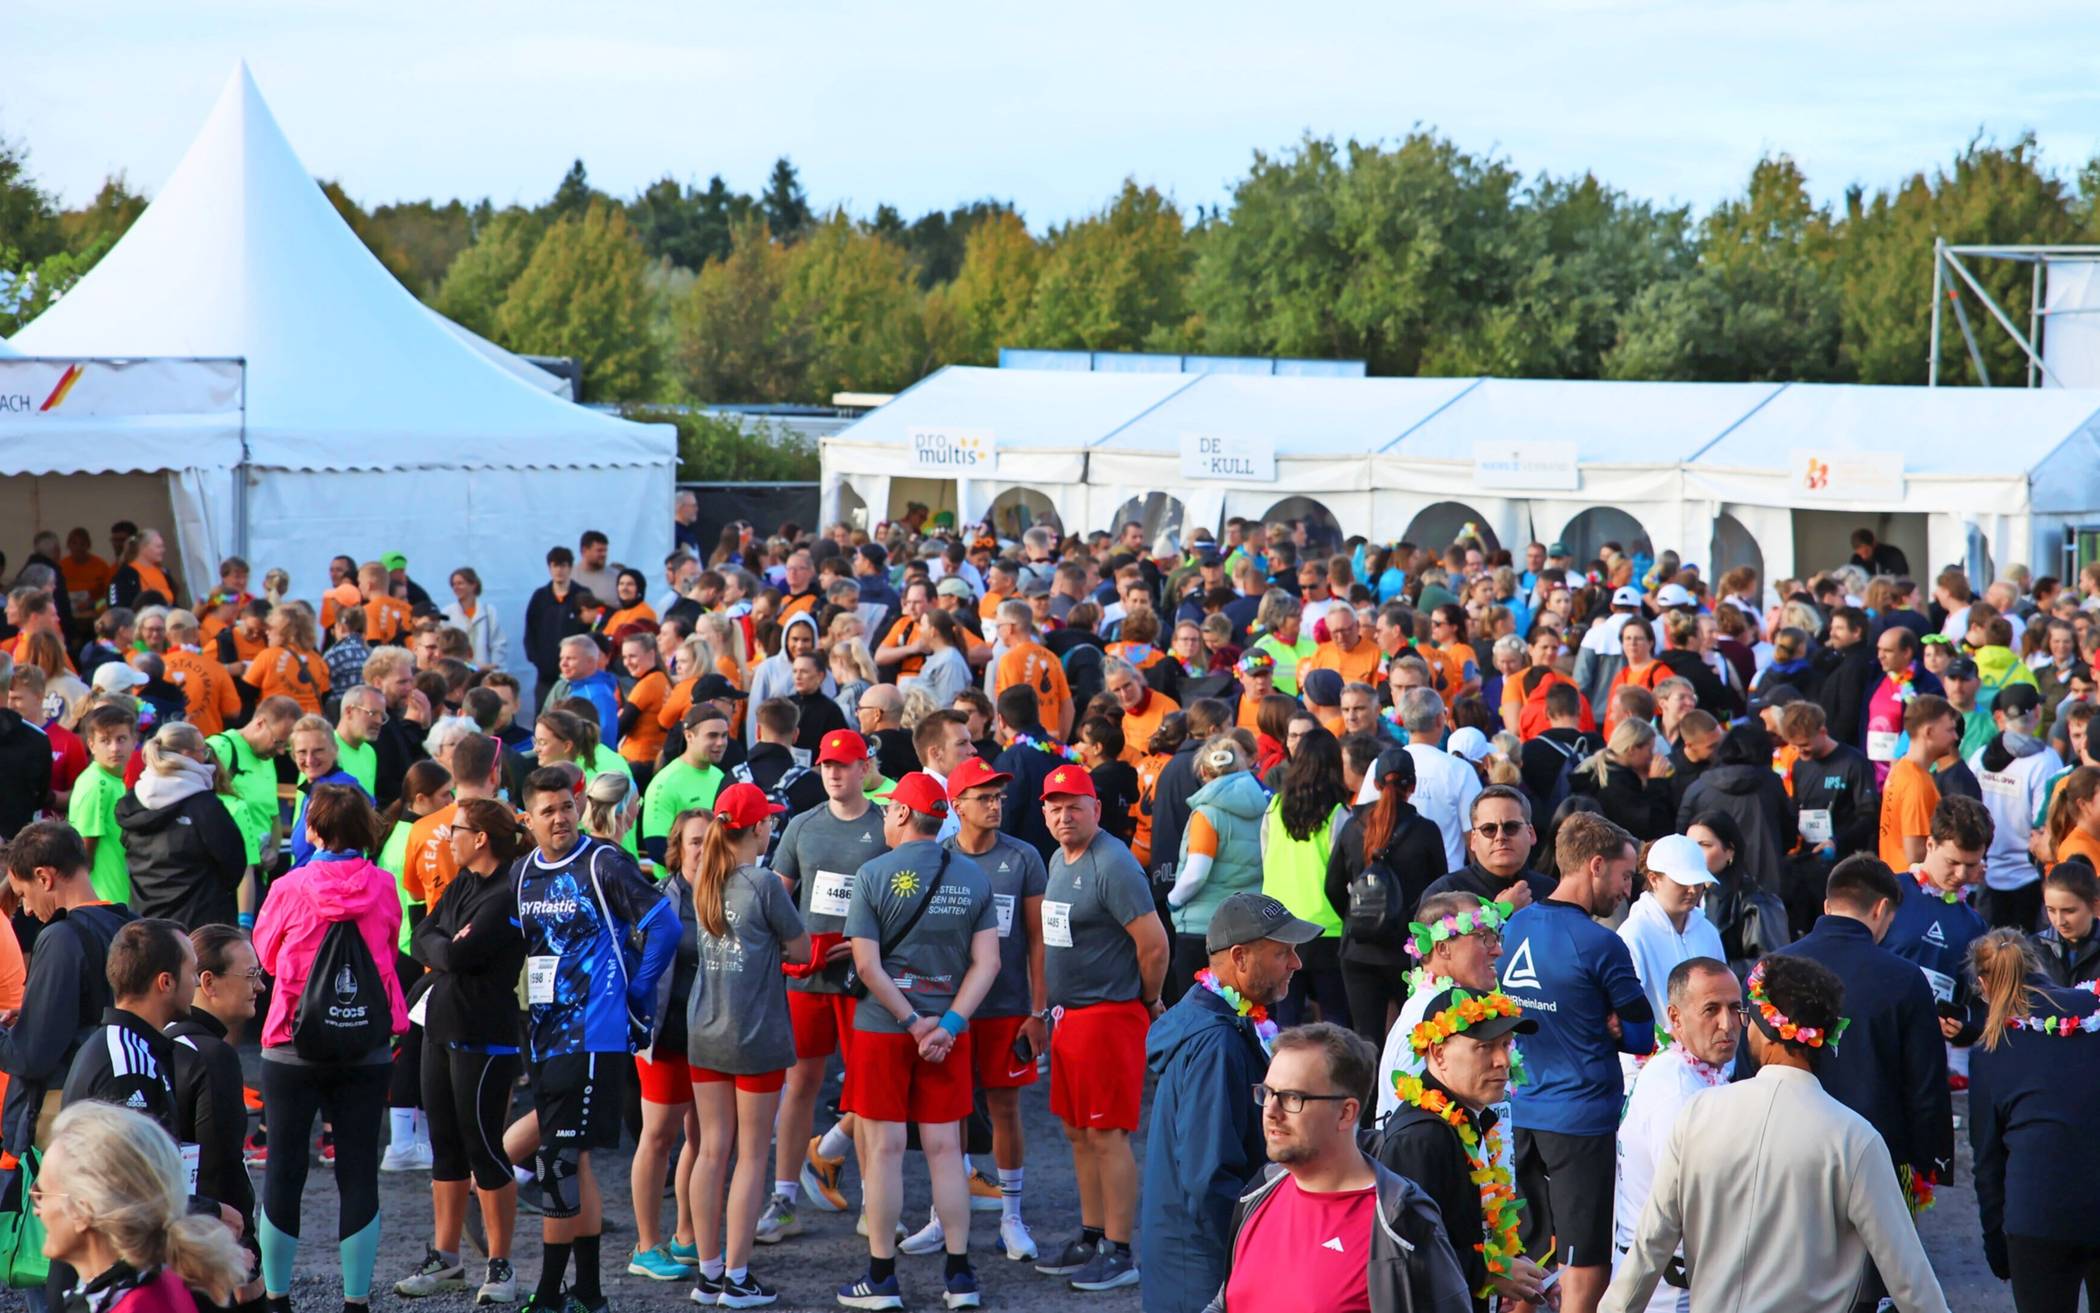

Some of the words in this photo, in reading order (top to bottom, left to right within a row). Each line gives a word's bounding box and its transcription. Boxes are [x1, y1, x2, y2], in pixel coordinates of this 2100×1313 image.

[0, 394, 30, 412] ACH
[915, 433, 946, 449] pro
[1200, 437, 1221, 453] DE
[919, 443, 977, 465] multis
[1211, 457, 1255, 474] KULL
[424, 824, 452, 873] TEAM
[826, 888, 852, 900] 4486
[940, 886, 971, 895] STELLEN
[521, 901, 577, 915] SYRtastic
[957, 897, 972, 905] DEN
[928, 906, 967, 915] SCHATTEN
[329, 1006, 366, 1018] crocs
[555, 1129, 577, 1137] JAKO
